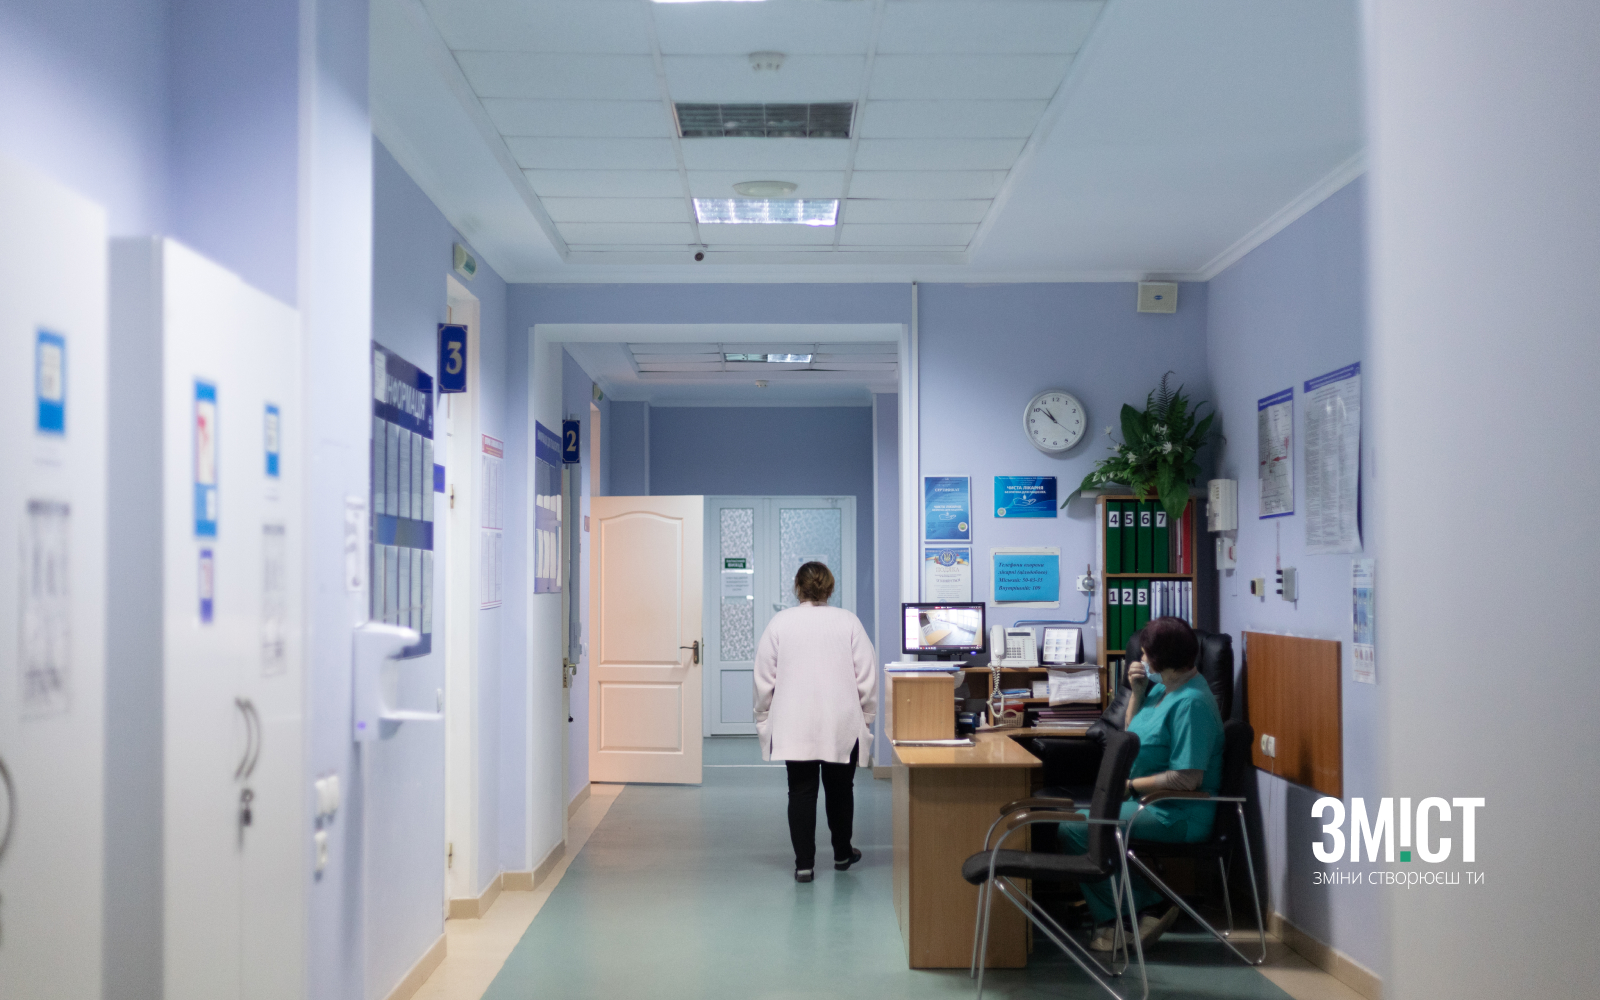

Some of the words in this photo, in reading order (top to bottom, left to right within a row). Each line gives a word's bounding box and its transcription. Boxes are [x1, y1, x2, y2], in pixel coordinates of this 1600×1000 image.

[445, 341, 463, 375] 3
[566, 430, 577, 452] 2
[1109, 513, 1119, 525] 4
[1125, 513, 1133, 525] 5
[1141, 513, 1150, 525] 6
[1157, 513, 1166, 525] 7
[1109, 591, 1118, 602] 1
[1124, 591, 1132, 602] 2
[1138, 591, 1147, 603] 3
